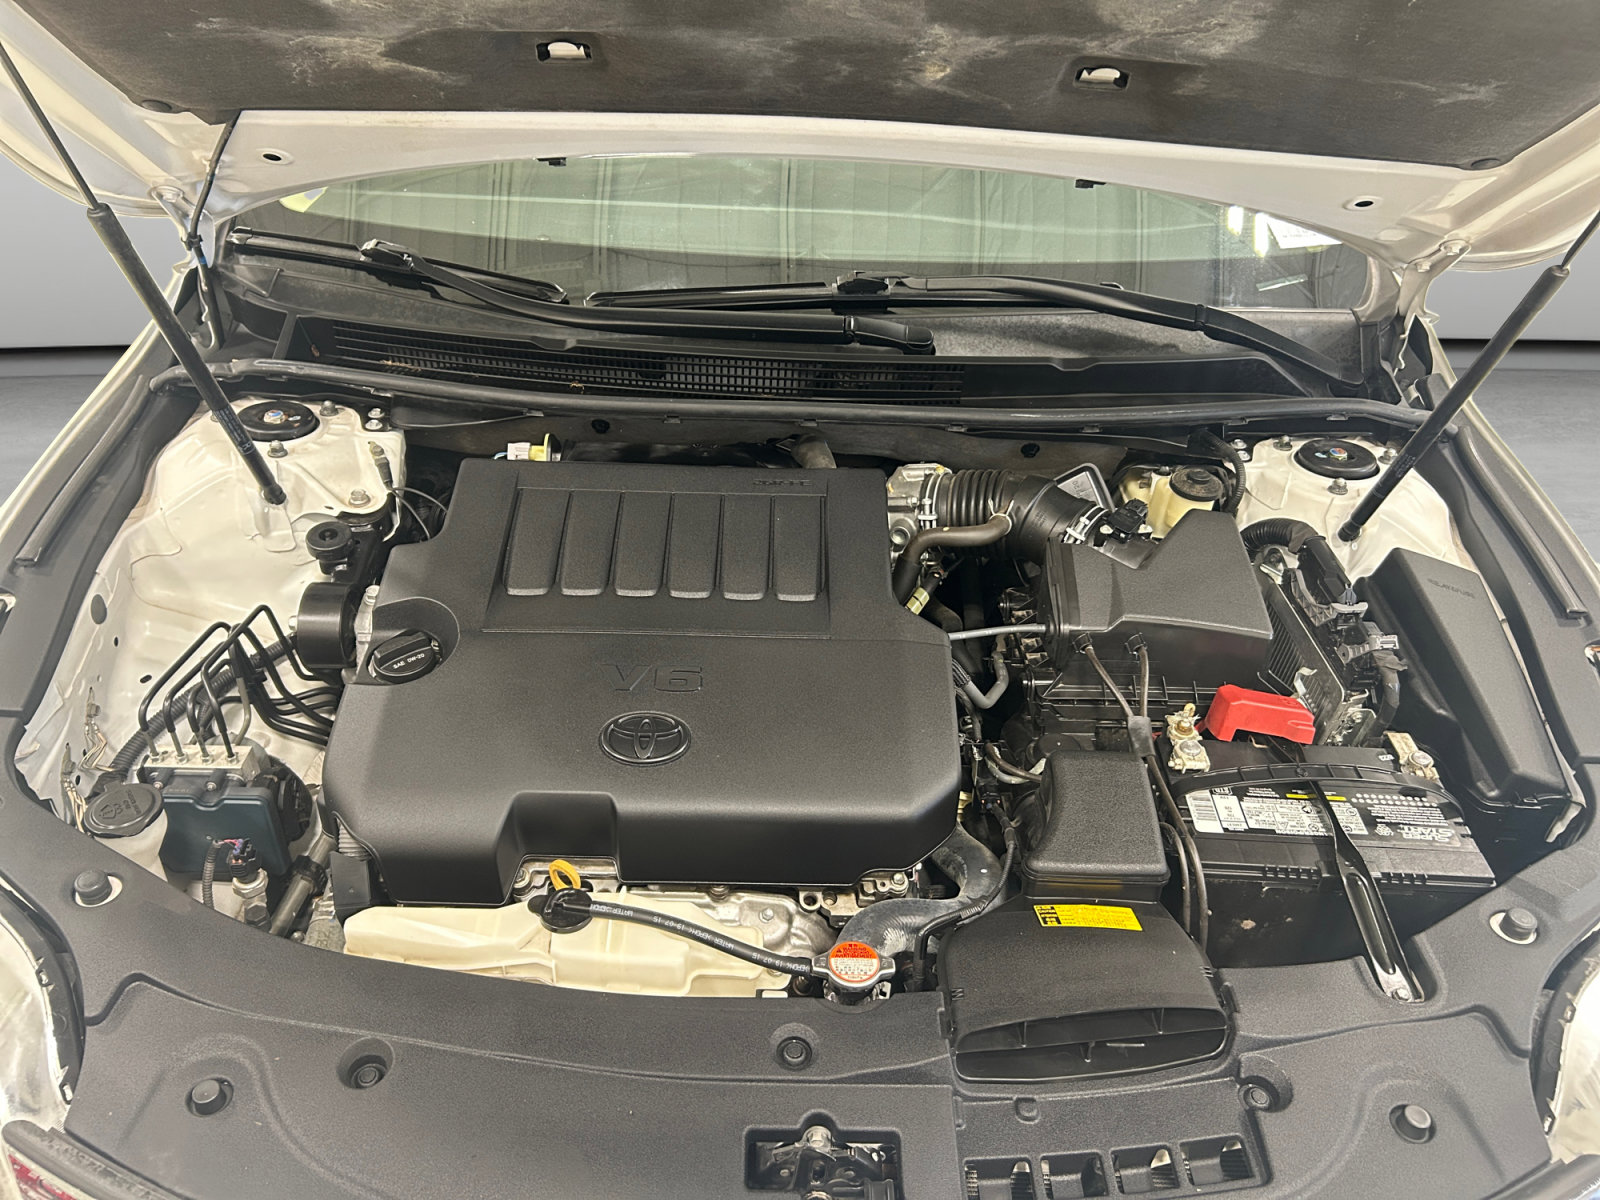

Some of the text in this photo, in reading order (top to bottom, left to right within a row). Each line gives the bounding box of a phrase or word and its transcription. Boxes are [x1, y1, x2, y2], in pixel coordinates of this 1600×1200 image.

[393, 660, 406, 669] SAE
[599, 663, 703, 693] V6
[1399, 824, 1454, 835] START
[1402, 832, 1450, 842] SUPER
[612, 907, 634, 917] WATER
[713, 936, 735, 951] WATER
